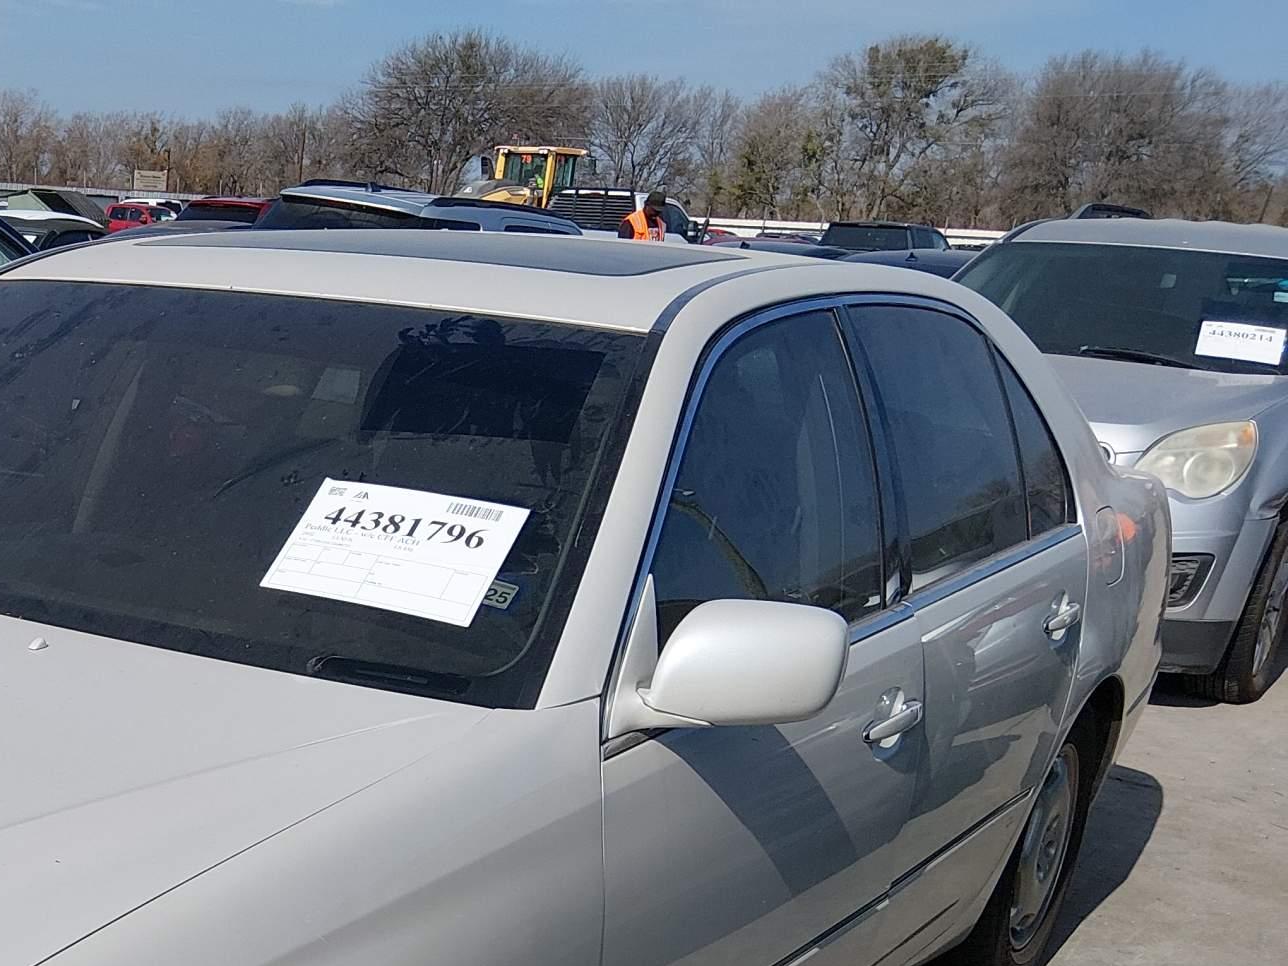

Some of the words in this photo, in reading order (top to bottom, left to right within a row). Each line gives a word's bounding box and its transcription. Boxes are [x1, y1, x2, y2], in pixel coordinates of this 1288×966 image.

[1209, 329, 1273, 342] 44380214
[324, 506, 489, 549] 44381796
[483, 588, 511, 604] 25
